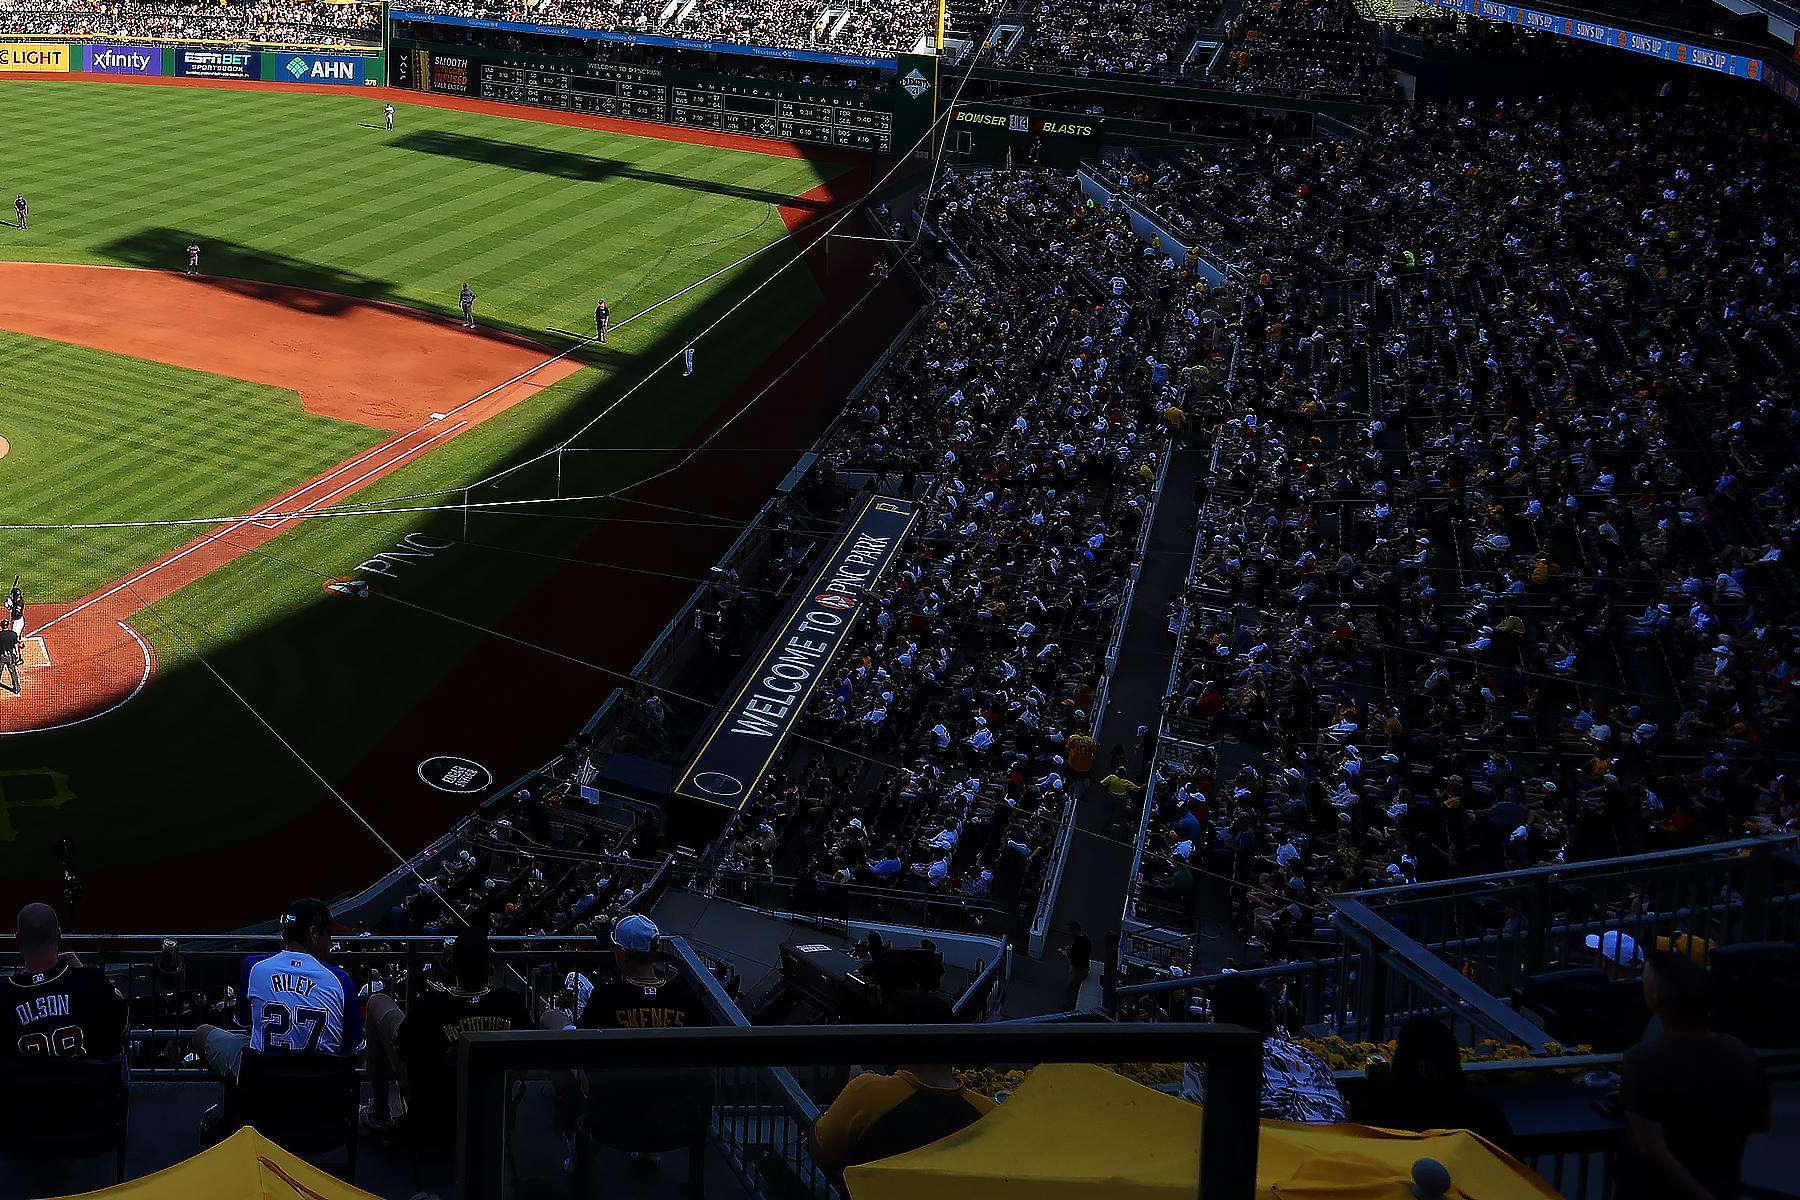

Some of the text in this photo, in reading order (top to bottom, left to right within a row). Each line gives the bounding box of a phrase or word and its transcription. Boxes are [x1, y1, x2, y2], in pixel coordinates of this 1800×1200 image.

[12, 50, 62, 65] LIGHT
[93, 48, 151, 71] xfinity
[434, 55, 468, 69] SMOOTH
[587, 62, 618, 72] WELCOME
[1692, 50, 1726, 69] SUN'S UP
[310, 60, 354, 80] AHN
[434, 72, 468, 85] INFUSED
[503, 60, 642, 81] NATIONAL LEAGUE
[697, 82, 784, 98] AMERICAN
[955, 111, 1007, 127] BOWSER
[1042, 121, 1092, 137] BLASTS
[352, 531, 456, 579] PNC
[825, 531, 892, 602] PNC PARK
[730, 609, 844, 738] WELCOME TO
[271, 972, 318, 998] RILEY
[15, 993, 70, 1027] OLSON
[261, 1000, 330, 1054] 27
